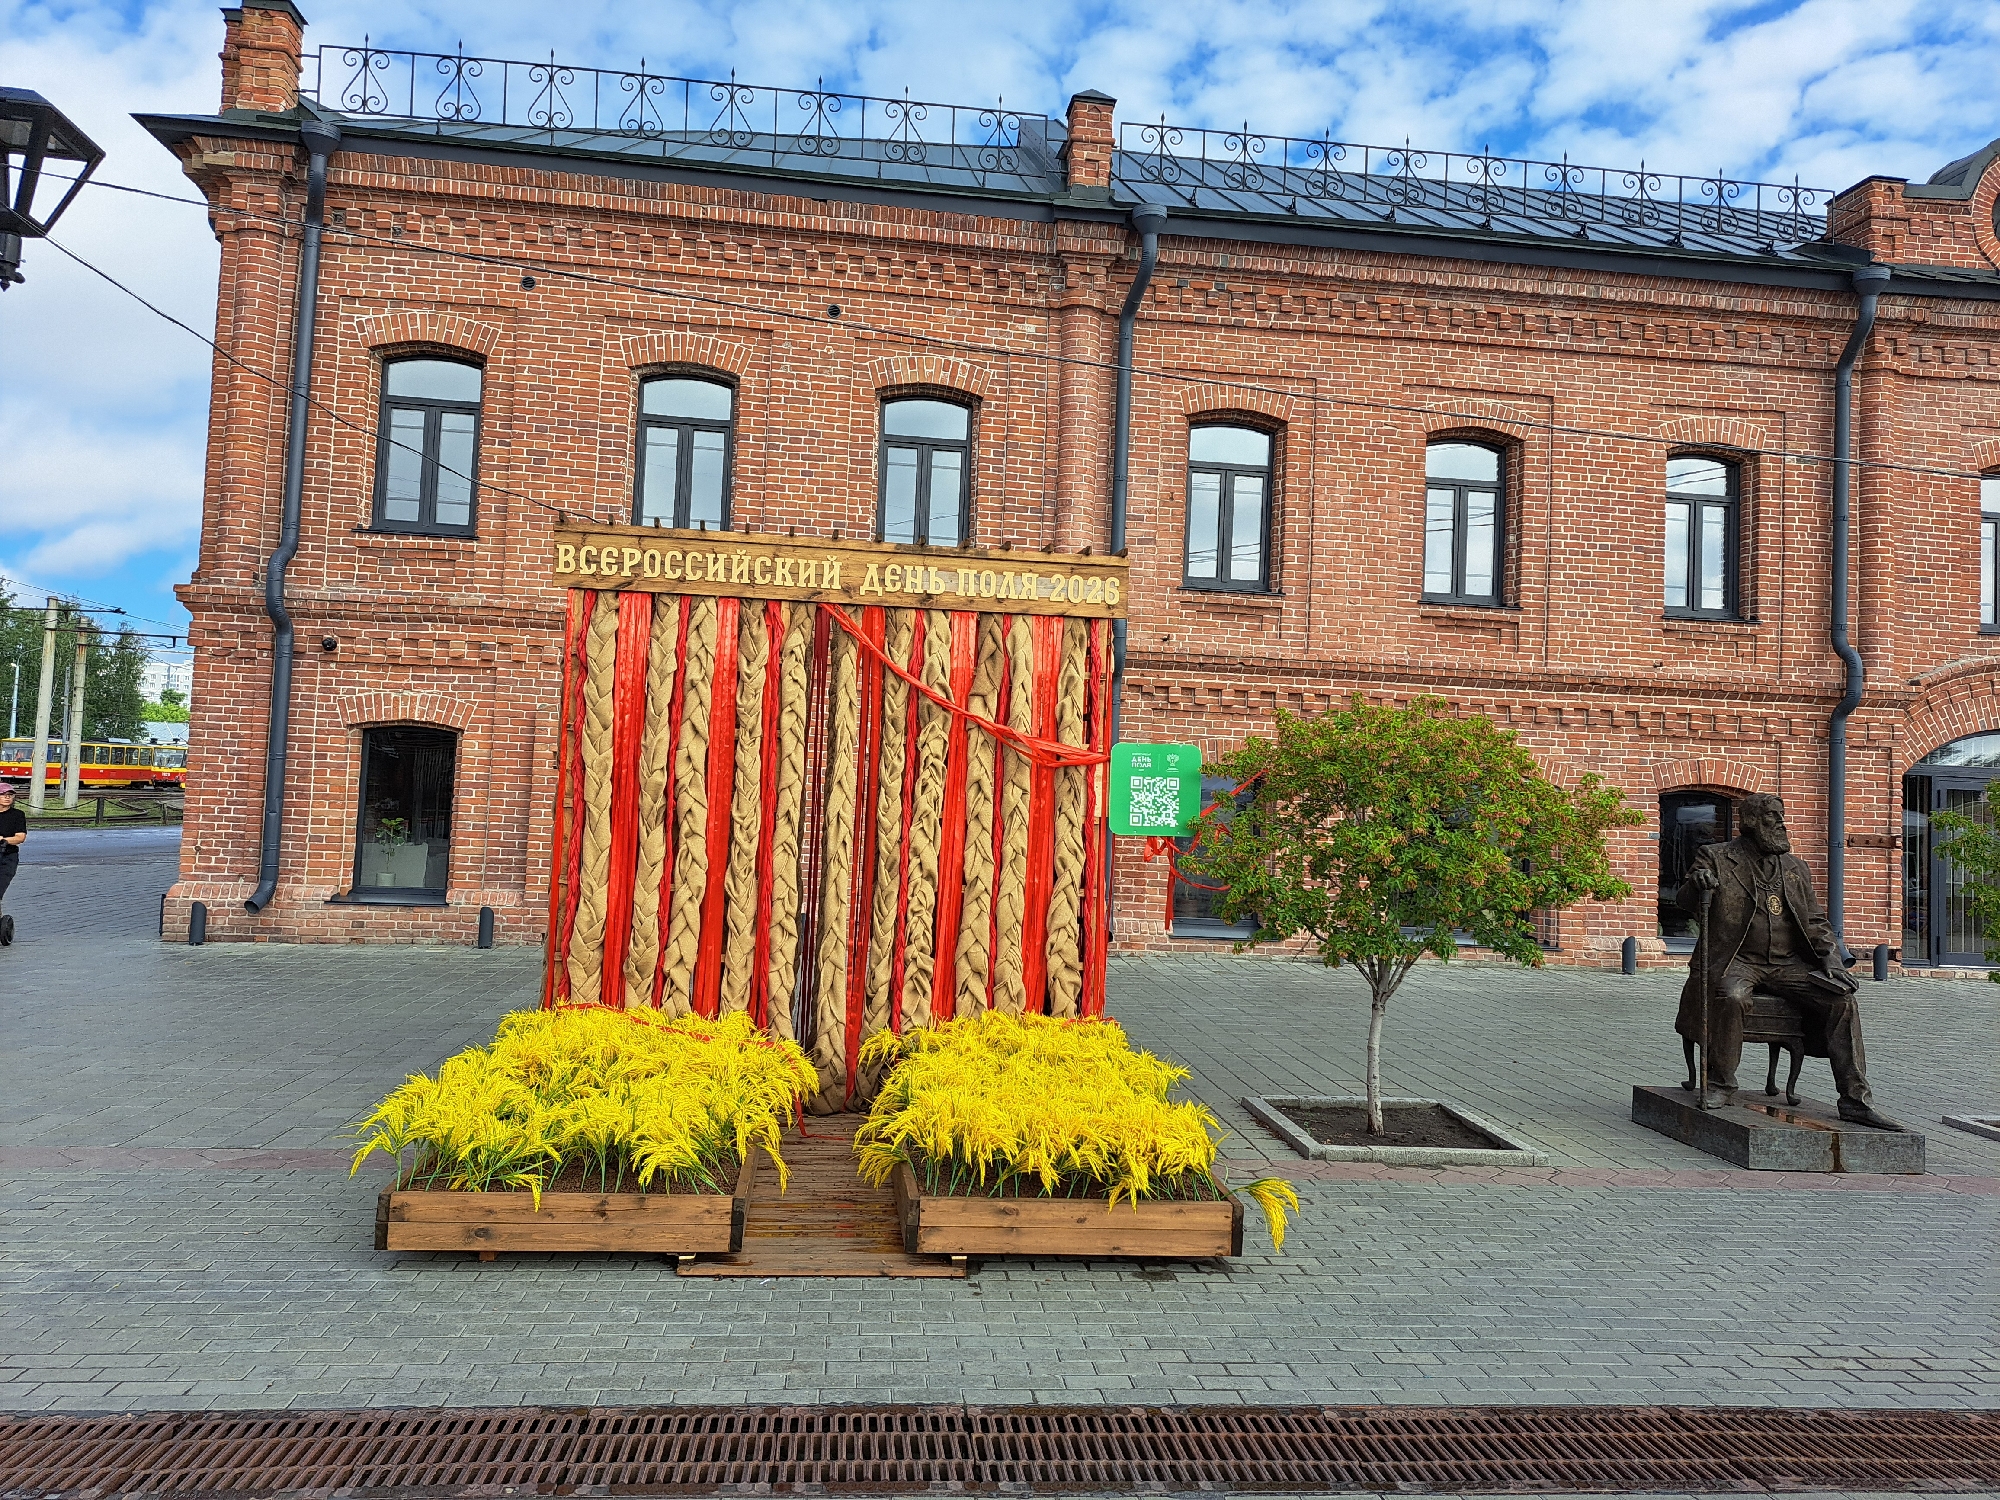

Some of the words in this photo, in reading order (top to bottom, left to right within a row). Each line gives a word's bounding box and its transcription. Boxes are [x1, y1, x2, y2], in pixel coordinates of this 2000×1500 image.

[555, 544, 842, 589] ВСЕРОССИЙСКИЙ
[860, 563, 945, 596] ДЕНЬ
[956, 568, 1039, 600] ПОЛЯ
[1050, 574, 1120, 605] 2026
